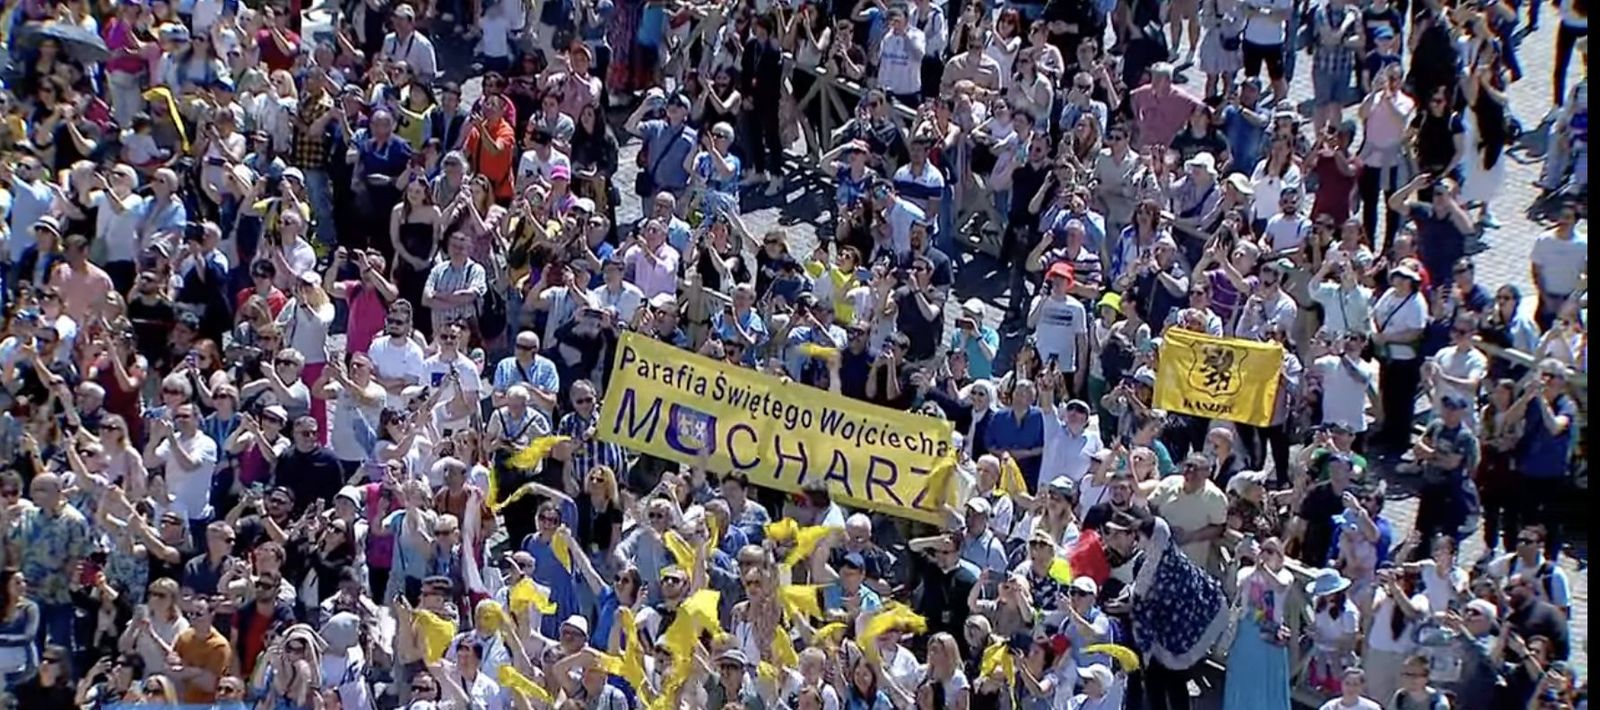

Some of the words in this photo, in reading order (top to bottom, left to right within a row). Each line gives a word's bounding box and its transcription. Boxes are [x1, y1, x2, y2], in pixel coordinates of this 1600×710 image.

[619, 345, 707, 397] Parafia
[711, 371, 813, 430] Świętego
[820, 407, 948, 457] Wojciecha
